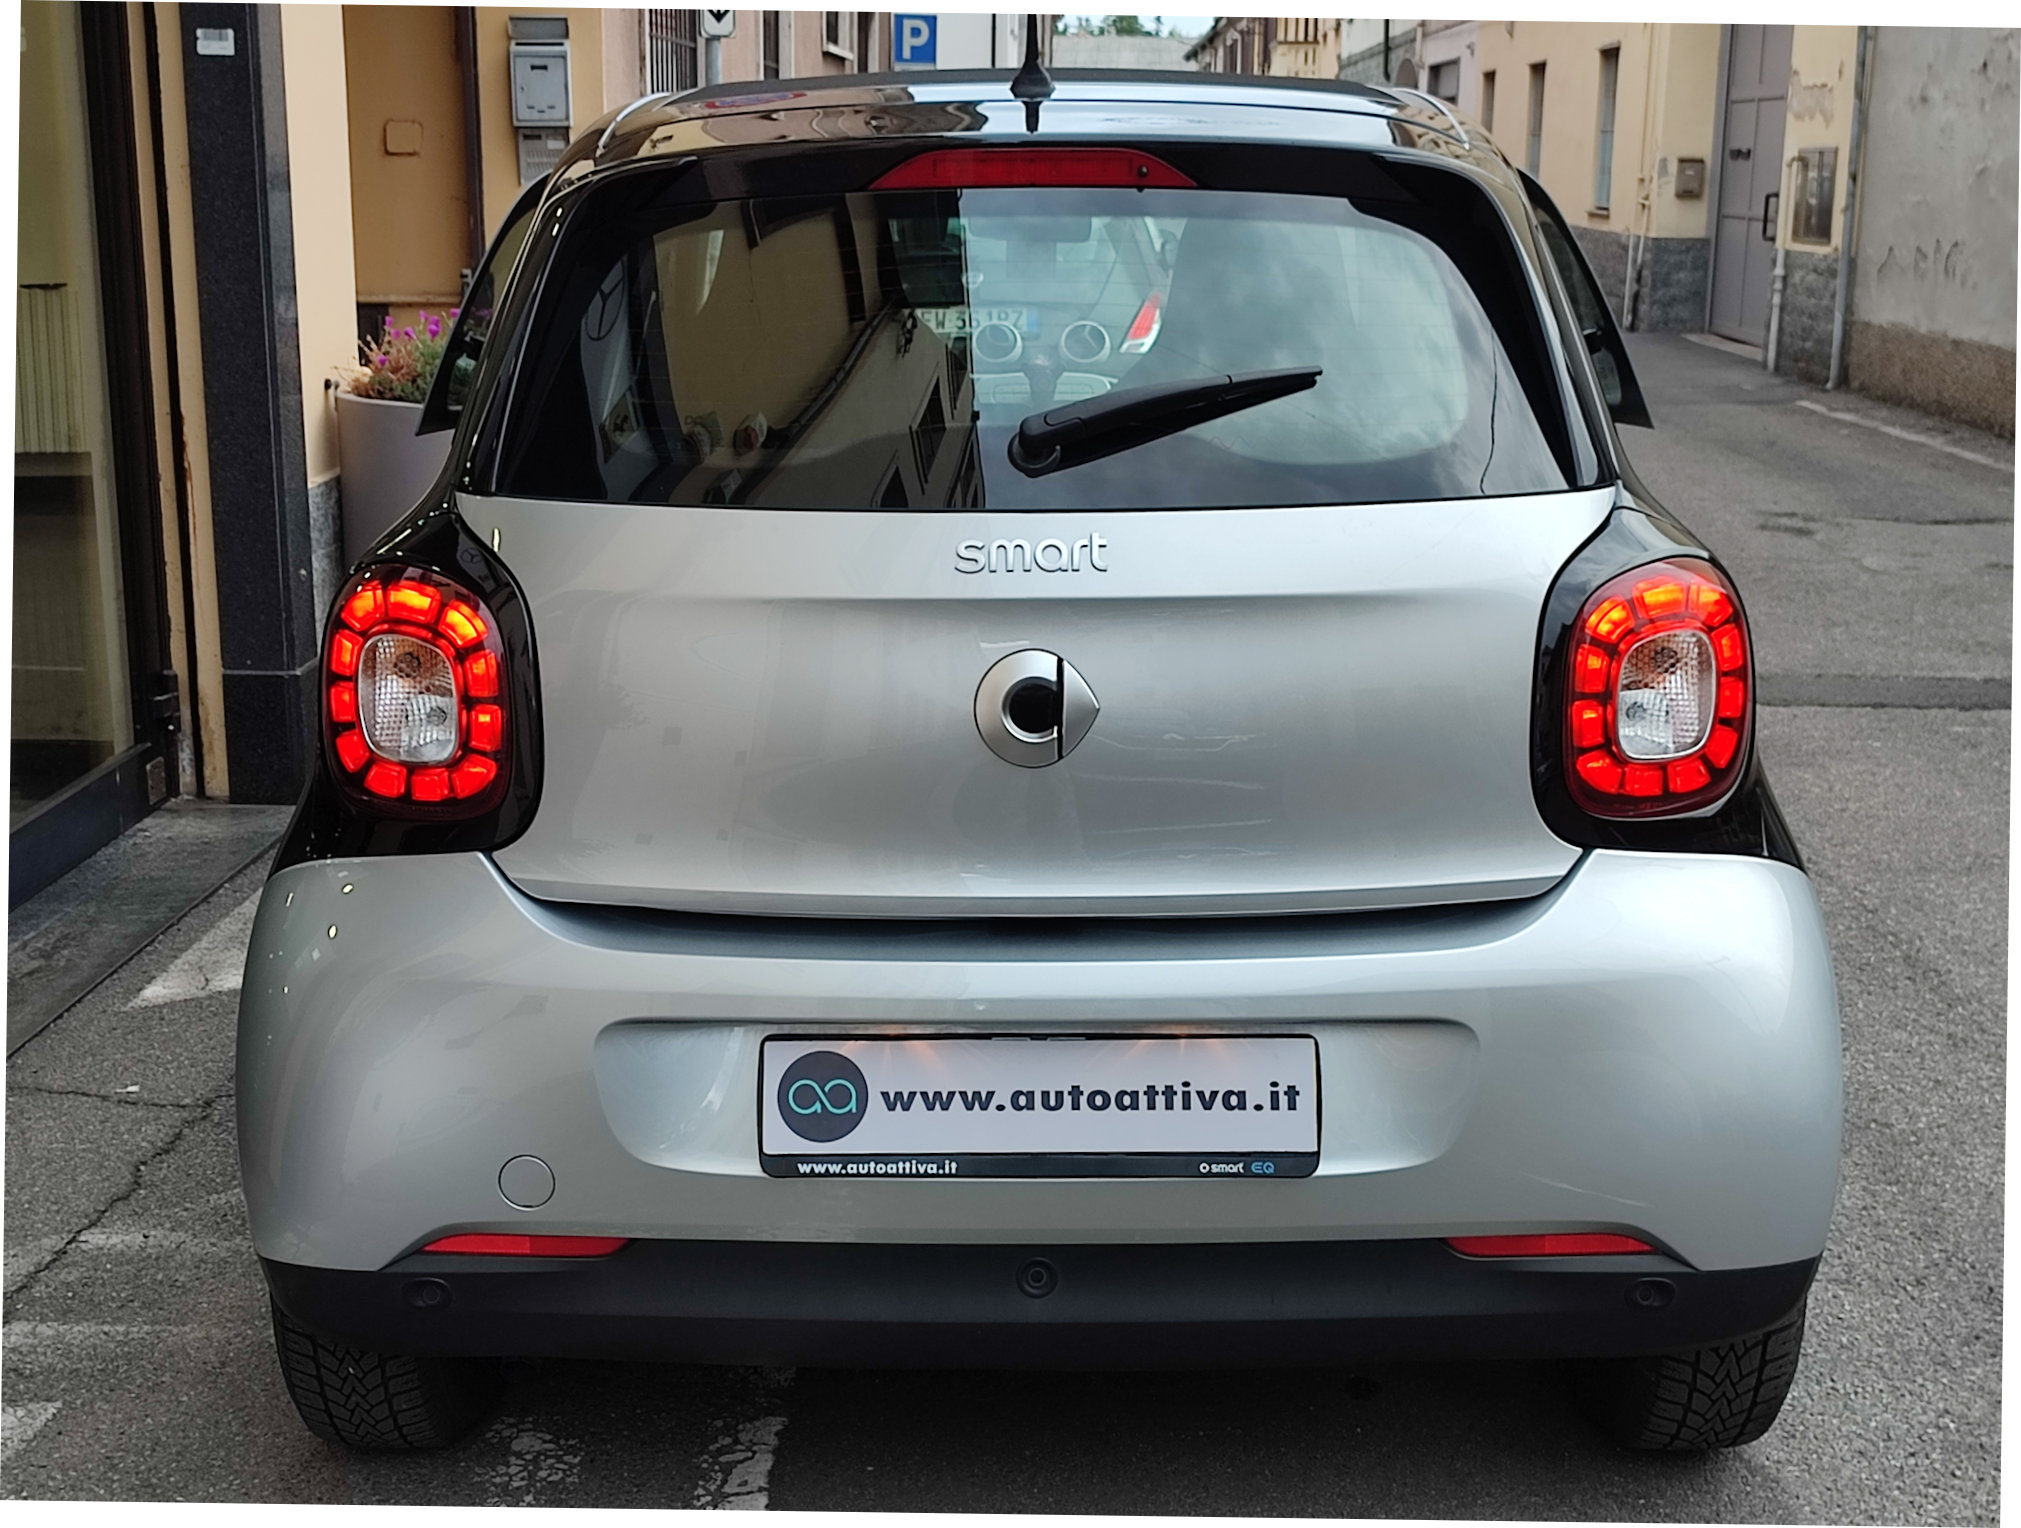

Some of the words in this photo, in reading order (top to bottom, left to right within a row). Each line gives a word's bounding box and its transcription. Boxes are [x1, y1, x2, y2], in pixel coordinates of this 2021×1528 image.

[902, 18, 929, 60] P
[954, 532, 1108, 575] smart
[880, 1080, 1300, 1112] www.autoattiva.it
[797, 1160, 958, 1175] www.autoattiva.it
[1210, 1162, 1245, 1174] smart
[1251, 1161, 1275, 1174] EQ
